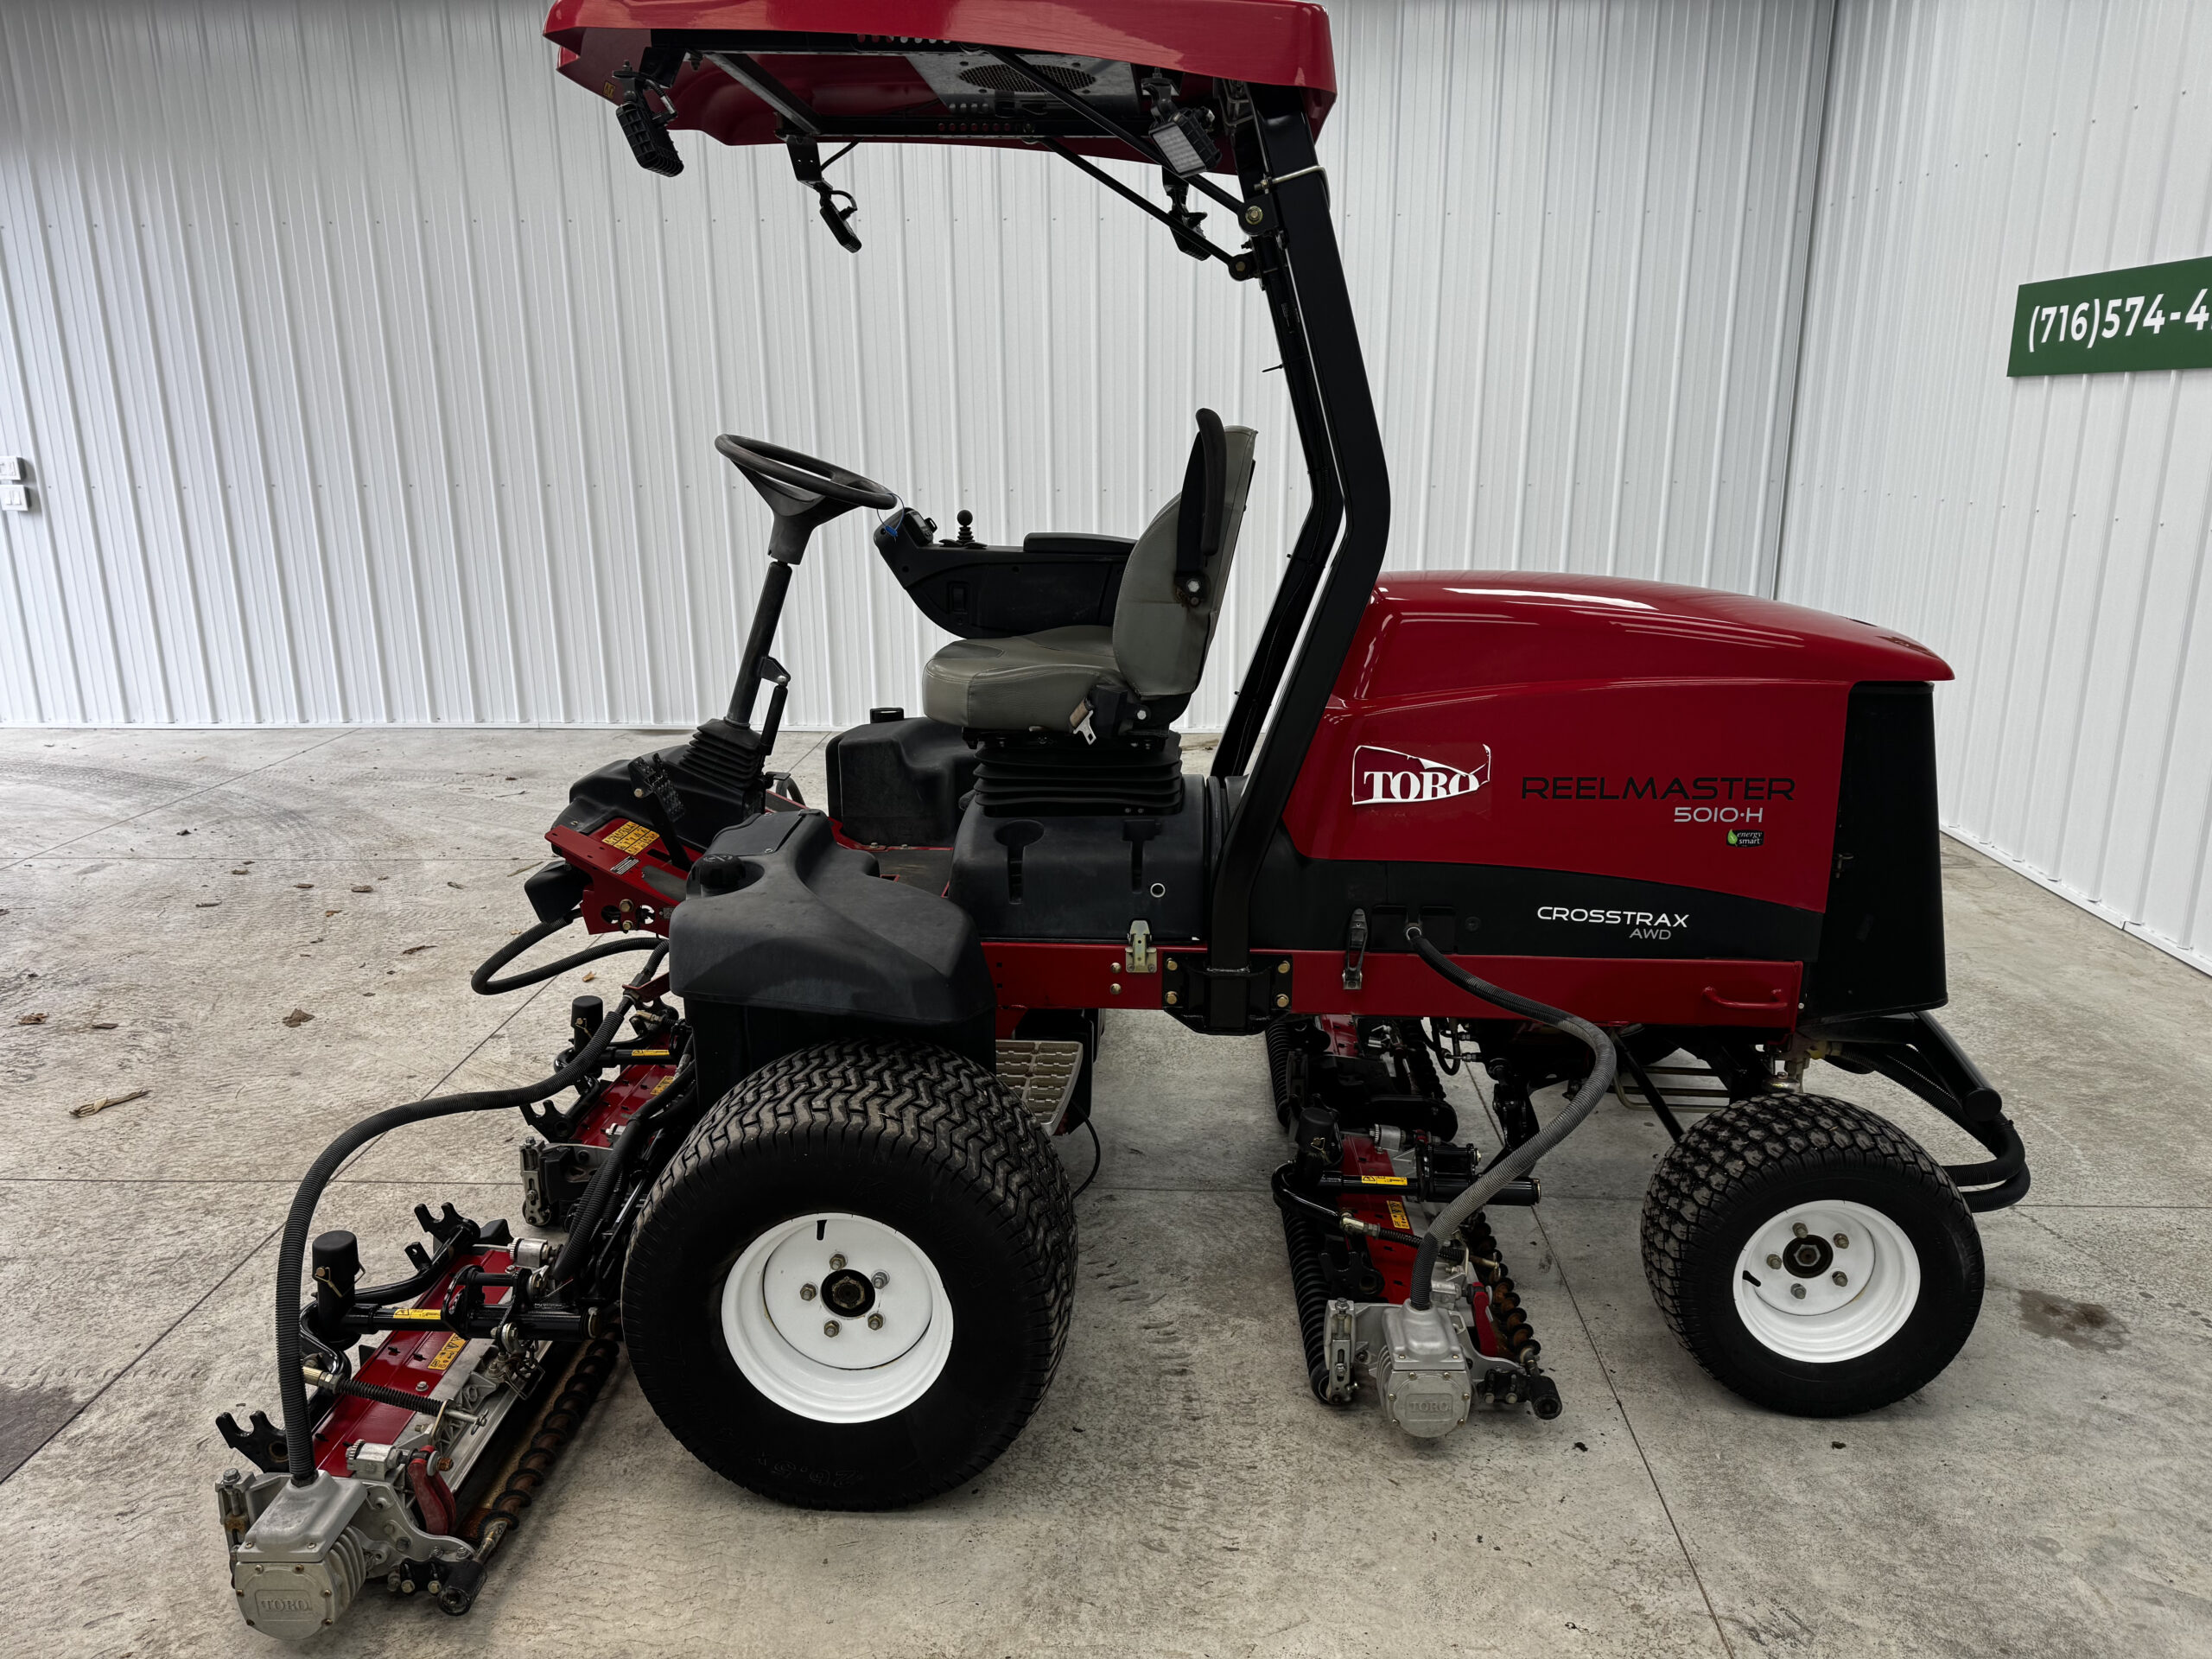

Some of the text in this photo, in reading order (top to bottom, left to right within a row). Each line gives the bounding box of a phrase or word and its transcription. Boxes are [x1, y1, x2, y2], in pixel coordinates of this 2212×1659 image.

[2028, 288, 2212, 353] (716)574-4
[1363, 771, 1479, 800] TORO
[1521, 776, 1796, 800] REELMASTER
[1537, 906, 1689, 928] CROSSTRAX
[1629, 928, 1671, 940] AWD
[1409, 1402, 1449, 1413] TORO
[261, 1599, 308, 1612] TORO
